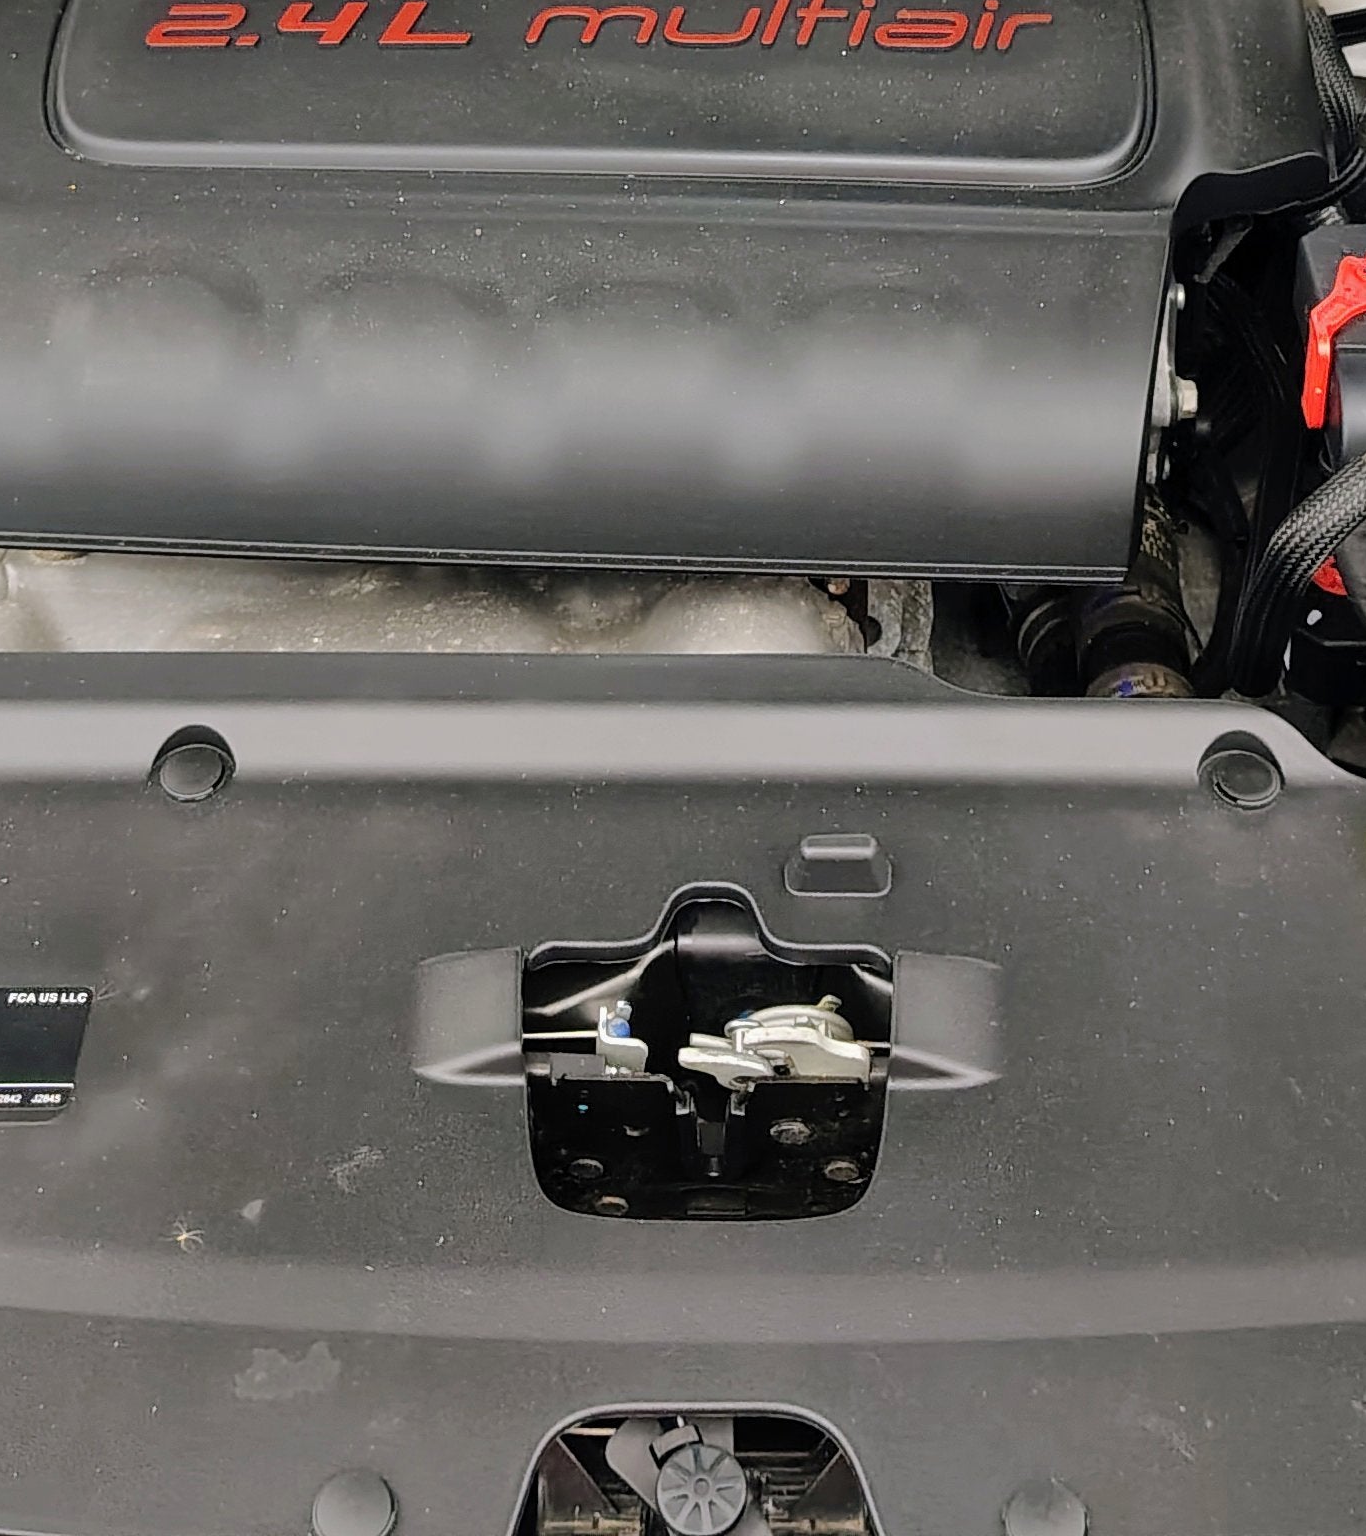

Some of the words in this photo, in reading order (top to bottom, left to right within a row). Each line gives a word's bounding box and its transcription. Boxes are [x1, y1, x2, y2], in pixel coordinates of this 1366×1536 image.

[144, 0, 472, 48] 2.4L
[7, 992, 36, 1004] FCA
[38, 992, 58, 1004] US
[60, 992, 88, 1004] LLC
